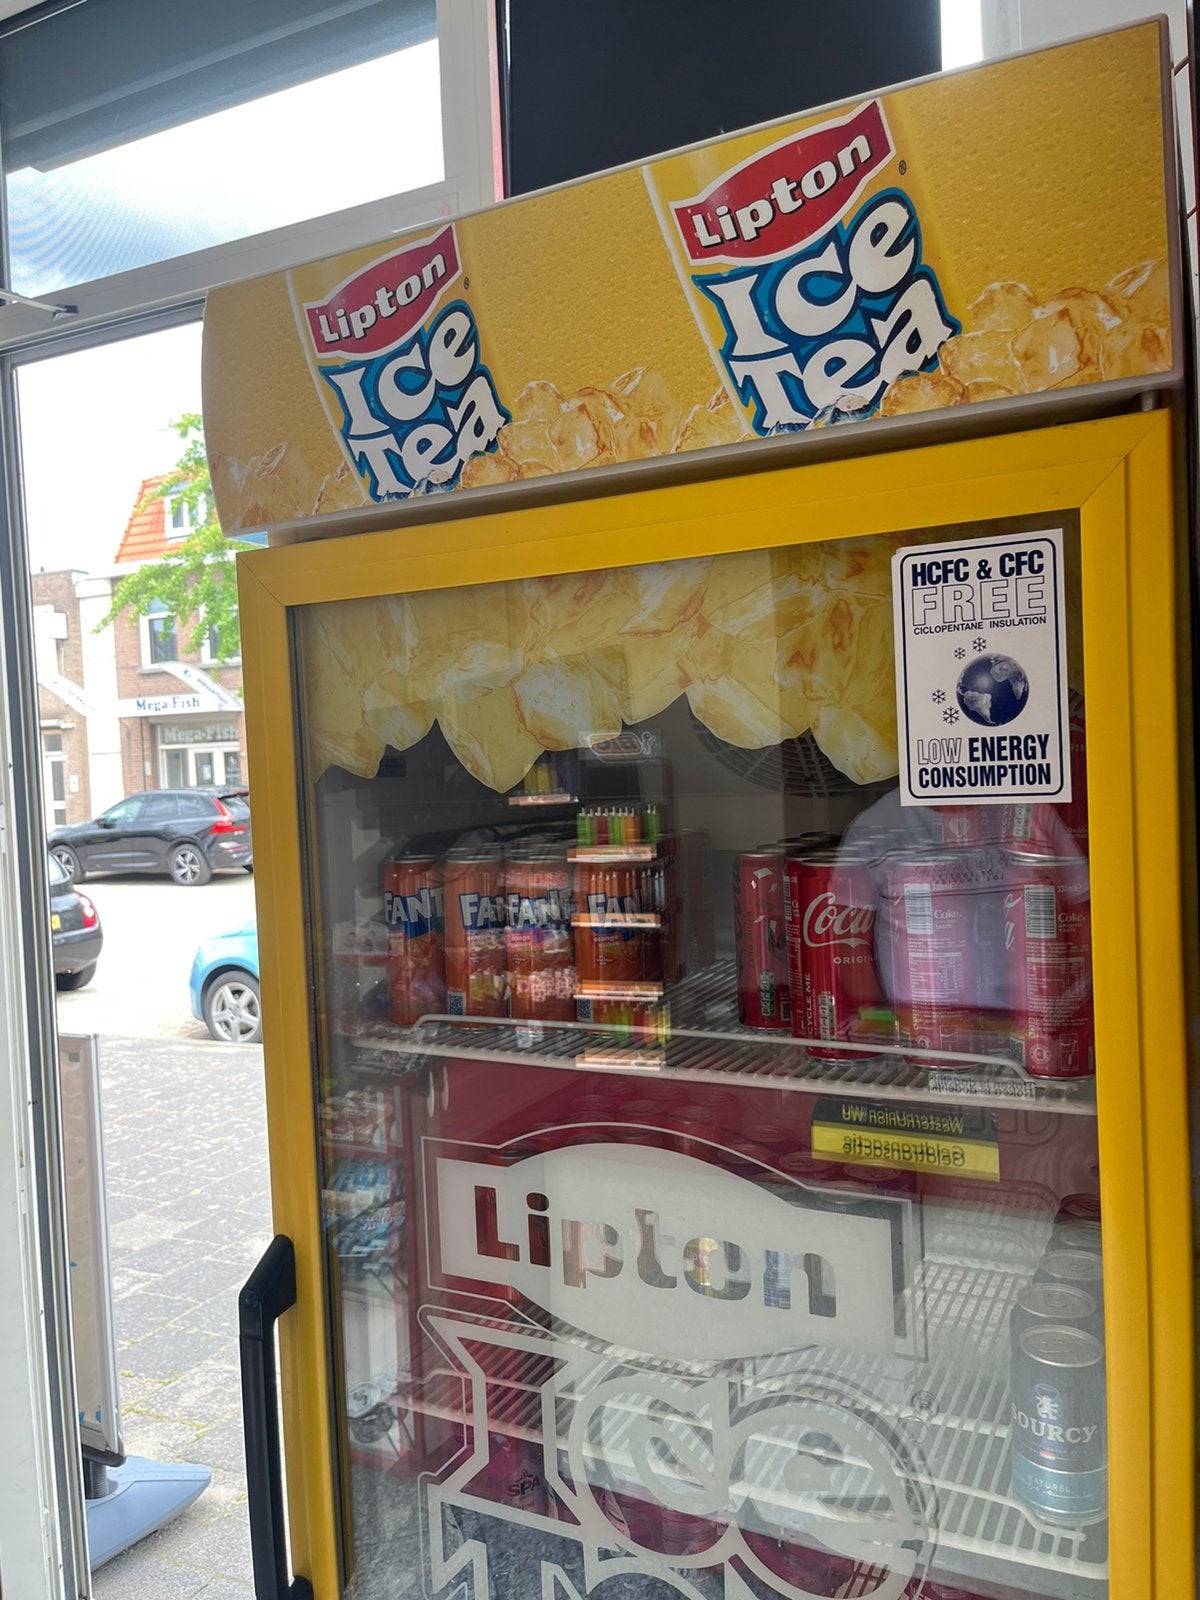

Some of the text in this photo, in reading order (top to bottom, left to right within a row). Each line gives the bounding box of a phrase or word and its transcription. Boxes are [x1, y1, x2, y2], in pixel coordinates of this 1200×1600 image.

[691, 134, 872, 249] Lipton
[318, 253, 446, 343] Lipton
[706, 201, 915, 356] Ice
[328, 311, 476, 435] Ice
[728, 279, 953, 428] Tea
[348, 375, 506, 497] Tea
[911, 549, 1044, 587] HCFC & CFC
[912, 575, 1047, 626] FREE
[913, 616, 1047, 636] CICLOPENTANE INSULATION
[917, 734, 1050, 765] LOW ENERGY
[918, 763, 1051, 789] CONSUMPTION
[384, 888, 444, 925] FANT
[587, 886, 642, 927] FAN
[473, 1184, 837, 1319] Lipton
[507, 1476, 541, 1497] SPA
